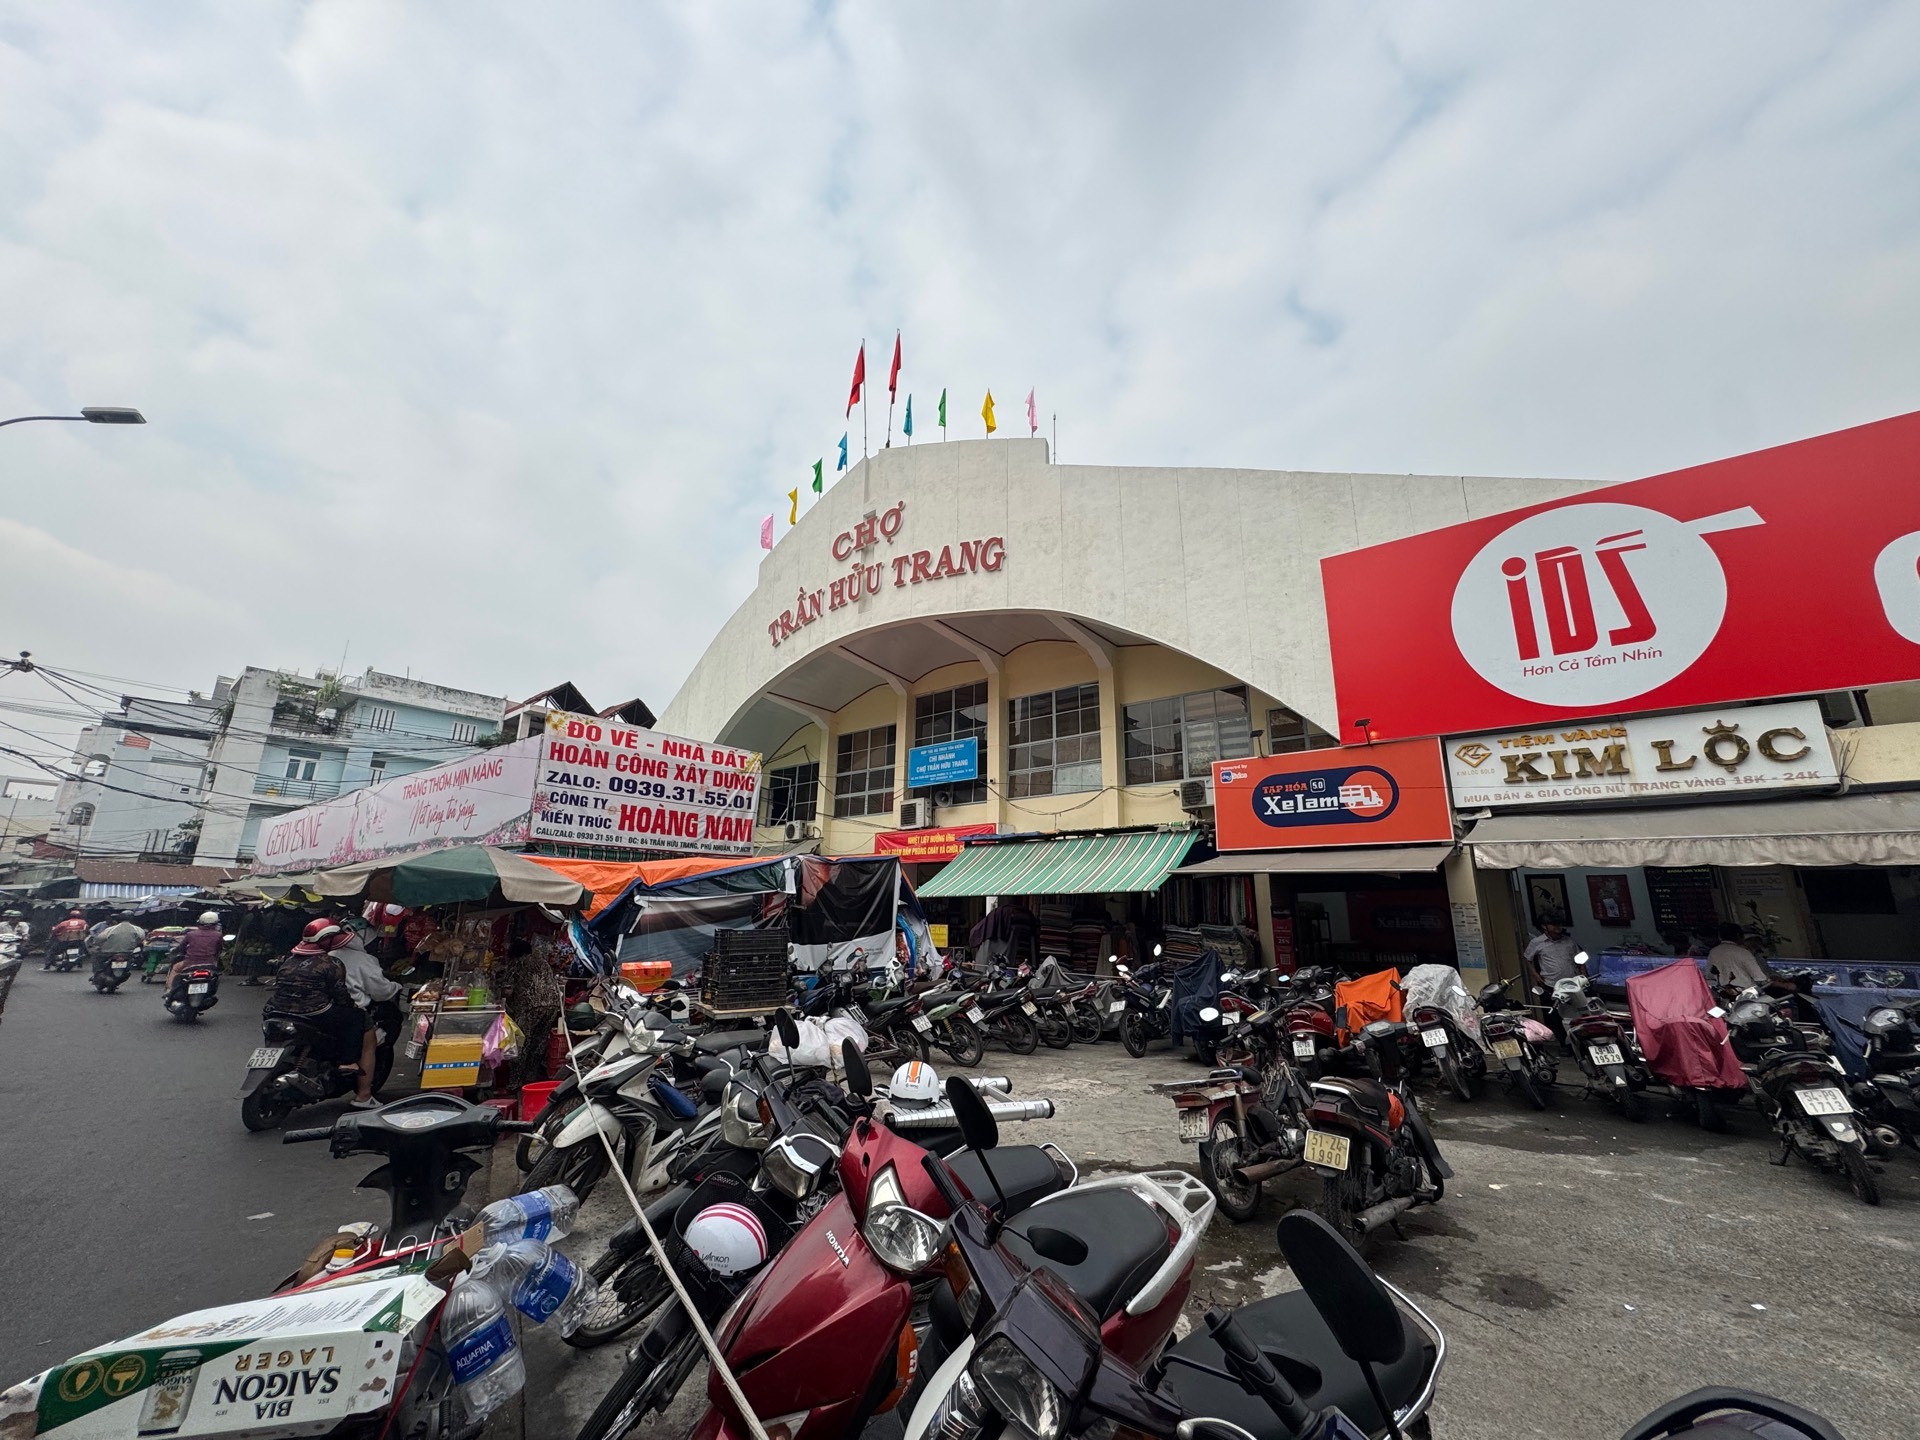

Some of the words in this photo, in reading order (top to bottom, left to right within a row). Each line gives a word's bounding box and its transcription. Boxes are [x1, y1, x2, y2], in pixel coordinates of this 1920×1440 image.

[831, 500, 906, 562] CHỢ
[768, 586, 825, 648] TRẦN
[828, 561, 884, 611] HỮU
[891, 536, 1006, 587] TRANG
[1522, 664, 1554, 678] Hơn
[1557, 657, 1580, 673] Cả
[1583, 652, 1619, 669] Tầm
[1622, 645, 1663, 663] Nhìn
[567, 721, 602, 742] ĐO
[611, 729, 639, 750] VẼ
[662, 739, 705, 762] NHÀ
[711, 749, 748, 769] ĐẤT
[1498, 734, 1555, 749] TIỆM
[1560, 726, 1627, 743] VÀNG
[472, 758, 503, 784] MÀNG
[550, 741, 609, 769] HOÀN
[615, 753, 668, 779] CÔNG
[674, 762, 708, 784] XÂY
[712, 771, 755, 794] DỰNG
[1500, 744, 1630, 784] KIM
[546, 770, 601, 789] ZALO:
[609, 776, 753, 810] 0939.31.55.01
[550, 791, 588, 808] CÔNG
[593, 796, 609, 810] TY
[1262, 784, 1283, 795] TẠP
[1285, 782, 1308, 792] HÓA
[1463, 794, 1490, 803] MUA
[1494, 790, 1520, 801] BÁN
[1538, 788, 1560, 799] GIA
[1563, 785, 1601, 797] CÔNG
[1631, 780, 1680, 792] TRANG
[1685, 776, 1726, 788] VÀNG
[1734, 774, 1766, 785] 18K
[1783, 770, 1820, 780] 24K
[540, 808, 574, 826] KIẾN
[578, 813, 612, 830] TRÚC
[618, 803, 699, 838] HOÀNG
[703, 814, 754, 842] NAM
[576, 831, 594, 841] 0939
[594, 833, 604, 841] 31
[605, 834, 614, 842] 55
[614, 835, 623, 843] 01
[1803, 1090, 1837, 1101] 54-P9
[1810, 1101, 1844, 1113] 1713
[1311, 1148, 1341, 1166] 1990
[825, 1230, 850, 1269] HONDA
[235, 1346, 335, 1371] LAGER
[456, 1340, 494, 1372] AQUAFINA
[212, 1366, 342, 1405] SAIGON
[256, 1400, 293, 1420] BIA
